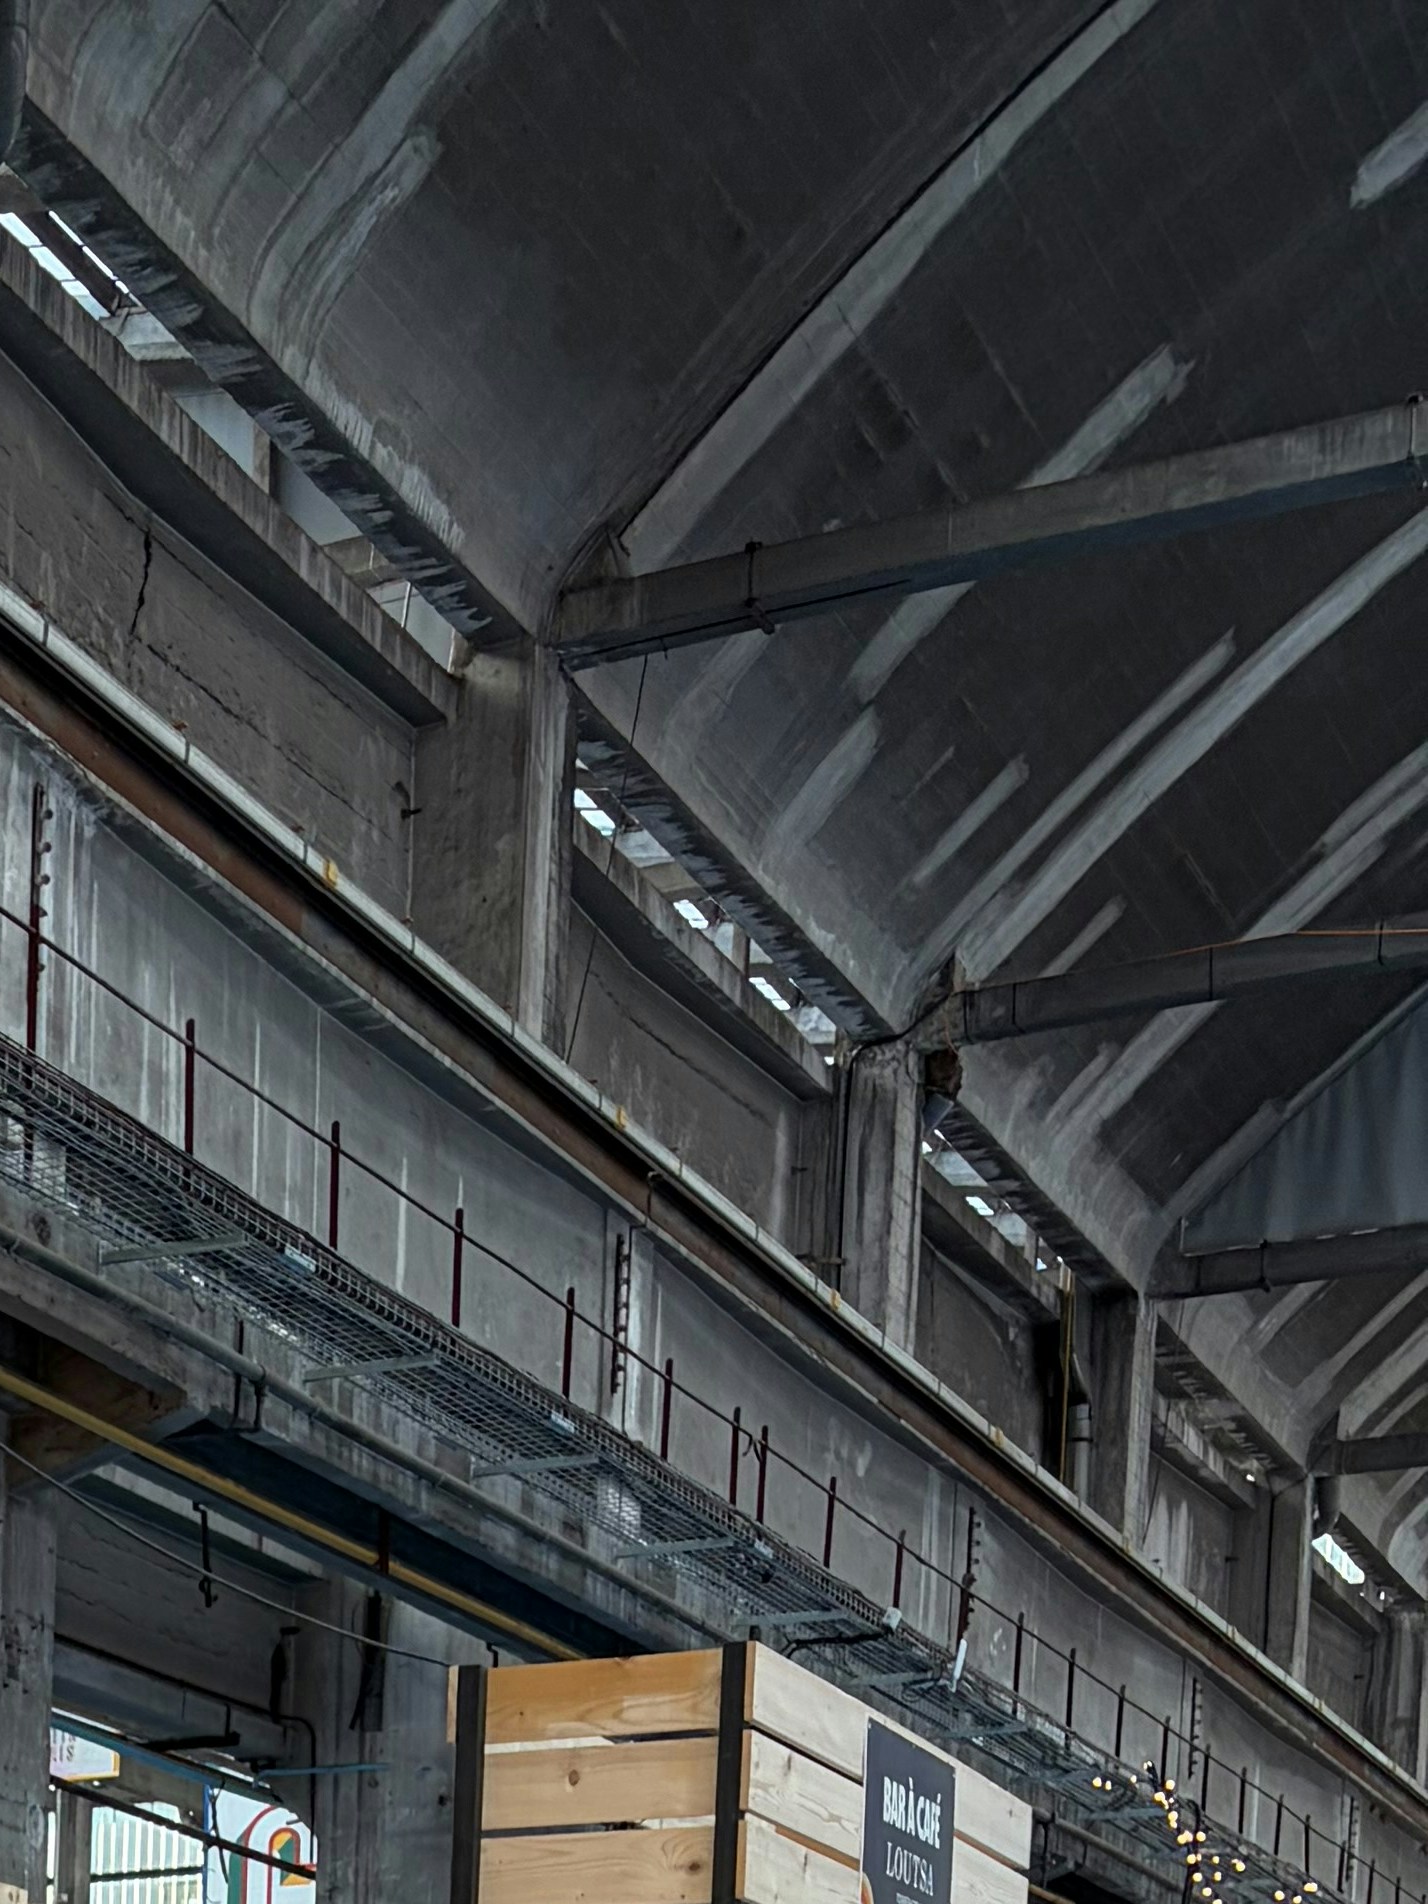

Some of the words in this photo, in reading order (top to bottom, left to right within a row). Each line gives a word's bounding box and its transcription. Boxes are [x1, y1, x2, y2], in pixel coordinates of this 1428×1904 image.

[883, 1776, 906, 1831] BAR
[907, 1776, 916, 1836] À
[916, 1793, 941, 1849] CAFÉ
[886, 1841, 934, 1897] LOUTSA
